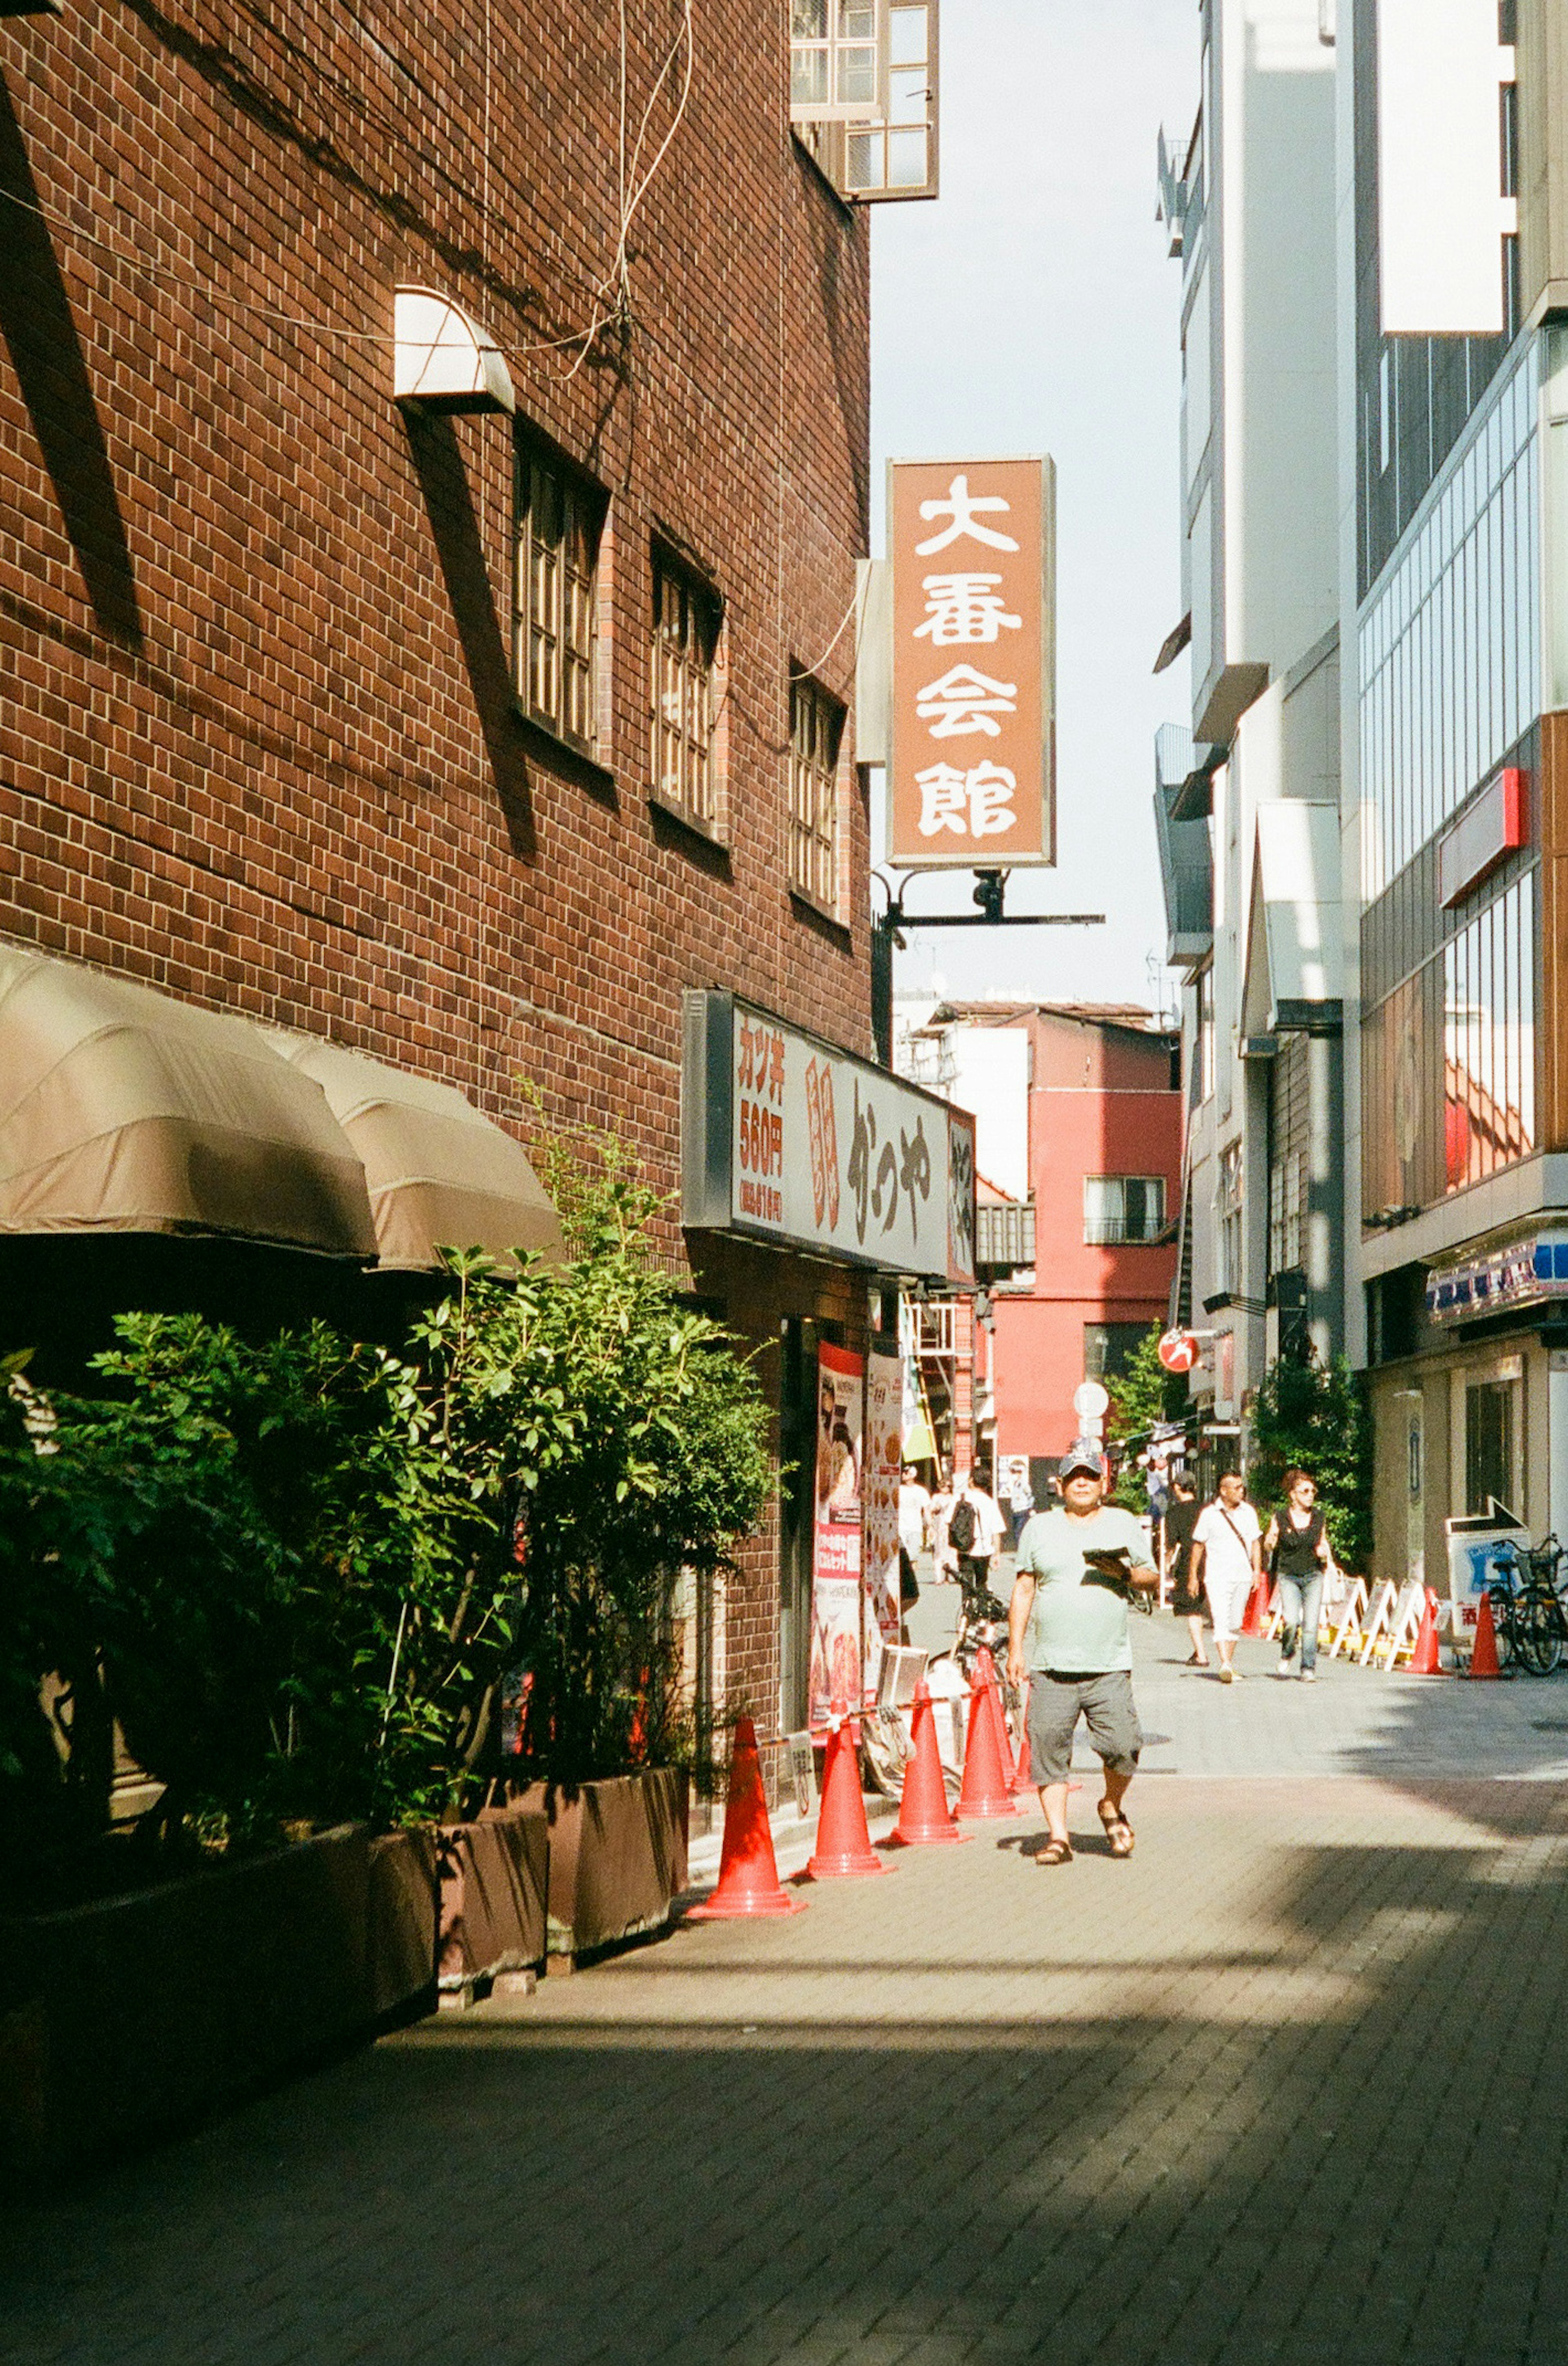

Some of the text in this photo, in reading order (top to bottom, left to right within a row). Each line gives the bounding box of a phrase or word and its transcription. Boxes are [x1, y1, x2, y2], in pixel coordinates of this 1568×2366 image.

[912, 474, 1022, 838] 大番会館
[739, 1099, 783, 1178] 560円
[848, 1076, 931, 1248] かつや
